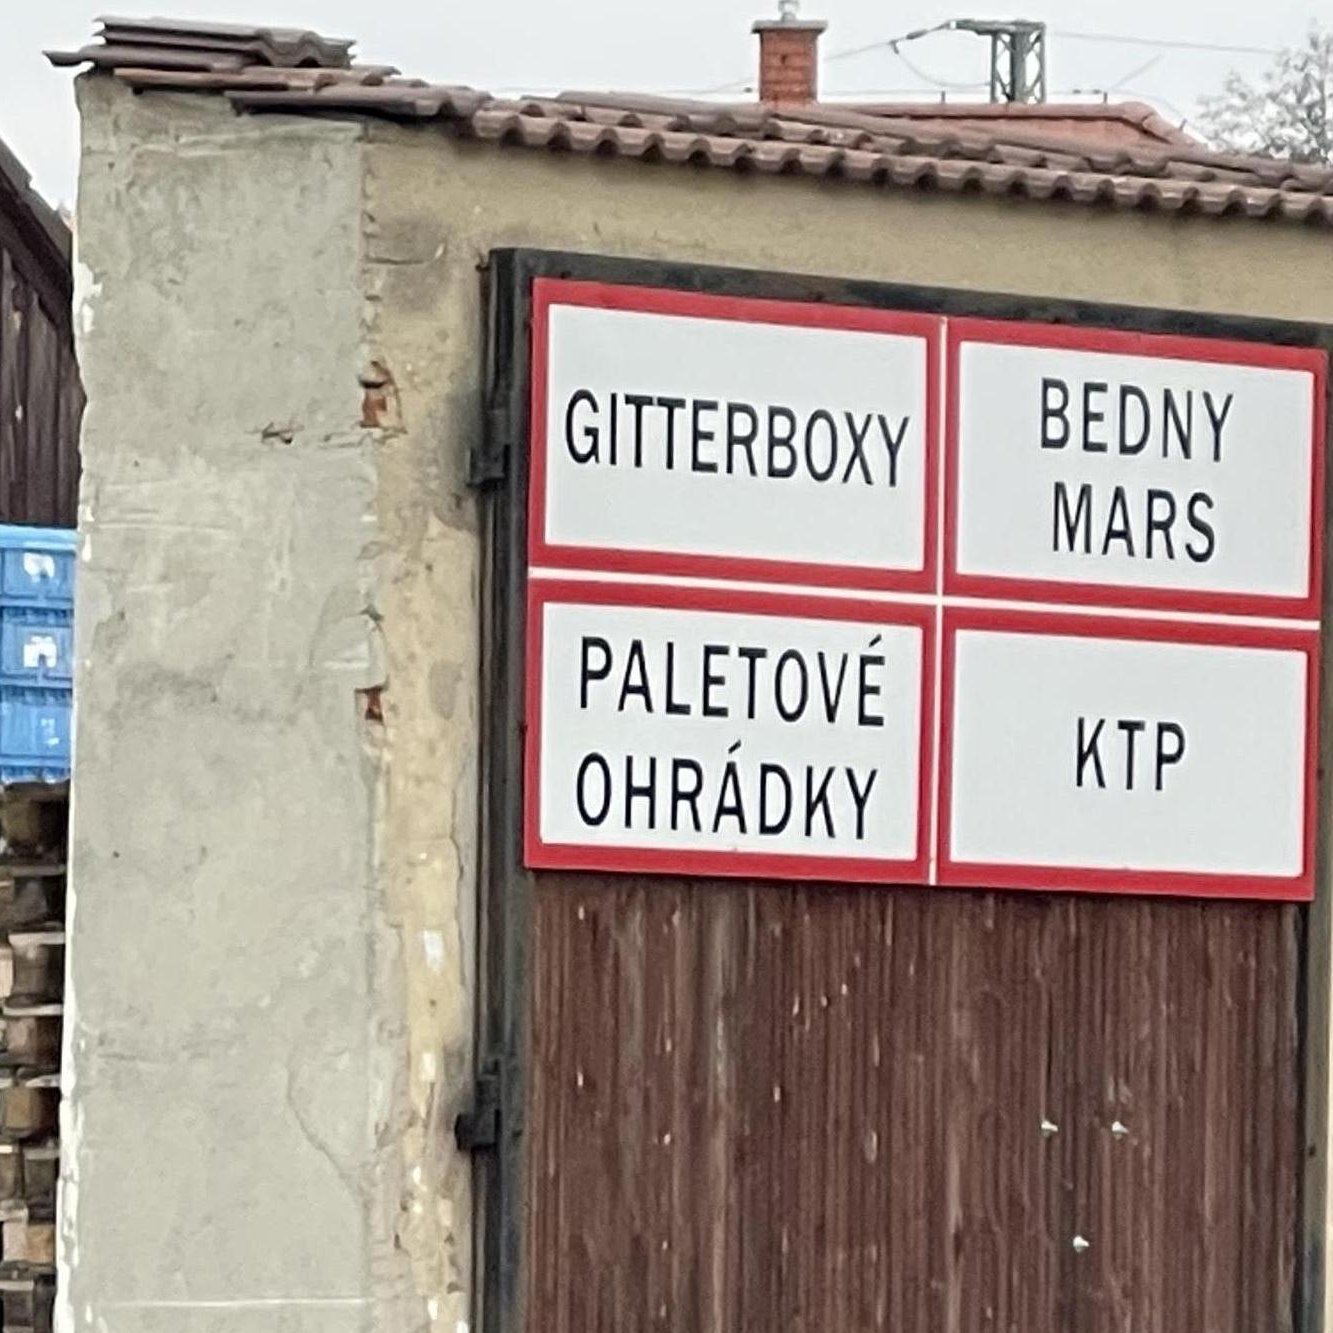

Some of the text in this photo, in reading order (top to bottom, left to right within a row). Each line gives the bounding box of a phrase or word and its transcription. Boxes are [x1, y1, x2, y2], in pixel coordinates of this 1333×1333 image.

[564, 388, 910, 488] GITTERBOXY
[1040, 377, 1235, 463] BEDNY
[1051, 480, 1217, 564] MARS
[579, 633, 887, 728] PALETOVÉ
[575, 740, 879, 841] OHRÁDKY
[1075, 716, 1187, 792] KTP
